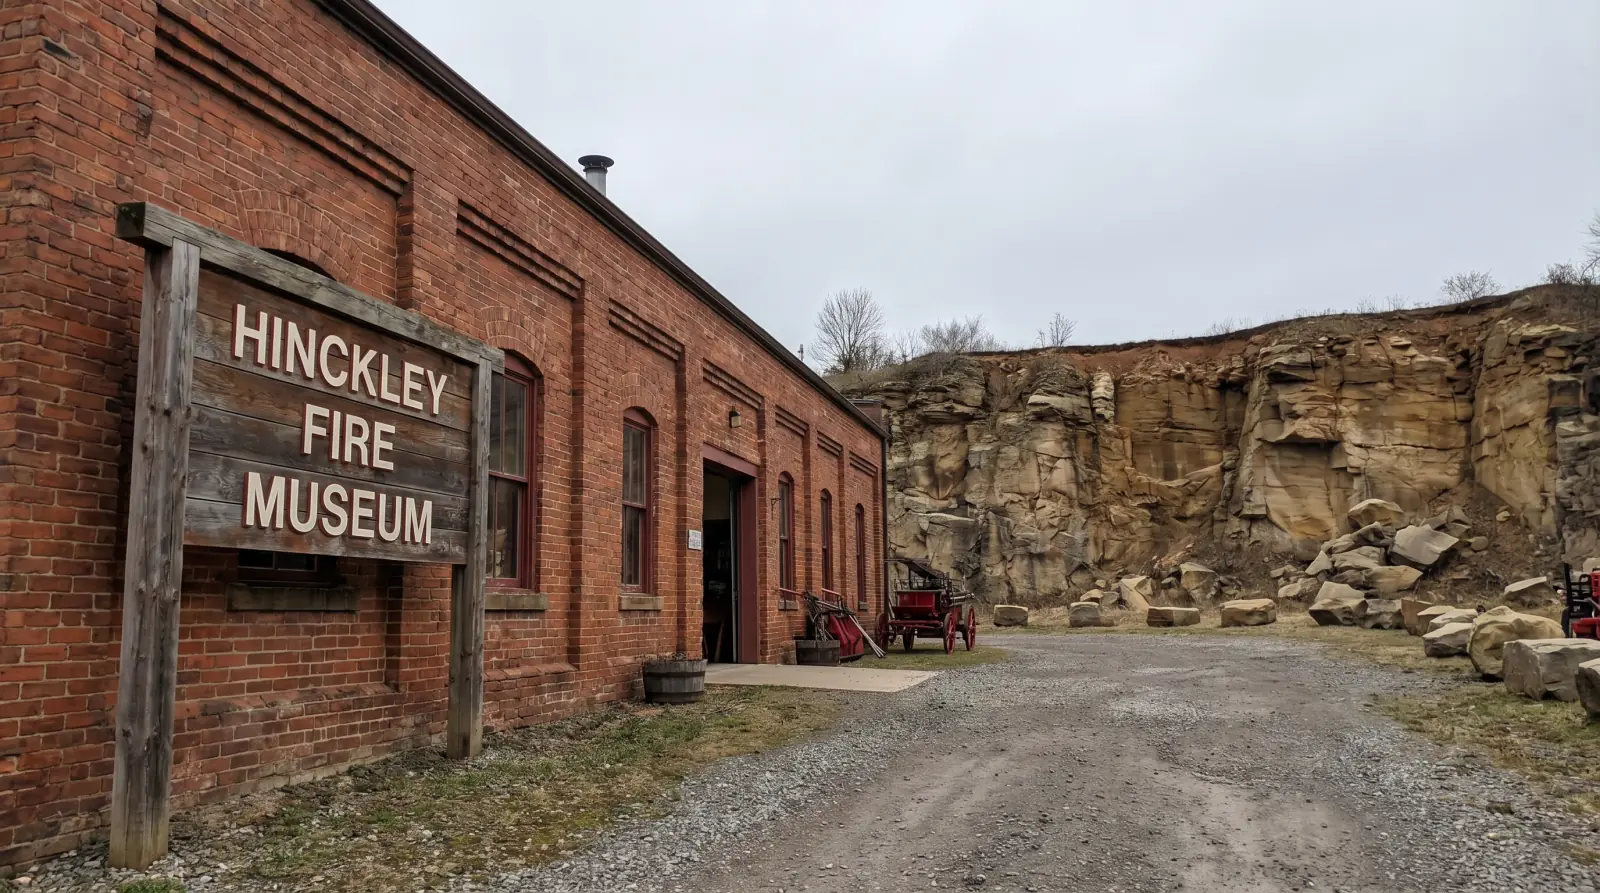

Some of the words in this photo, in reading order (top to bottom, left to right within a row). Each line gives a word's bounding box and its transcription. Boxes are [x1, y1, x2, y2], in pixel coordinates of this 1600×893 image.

[233, 303, 448, 416] HINCKLEY
[302, 403, 396, 471] FIRE
[243, 471, 433, 545] MUSEUM
